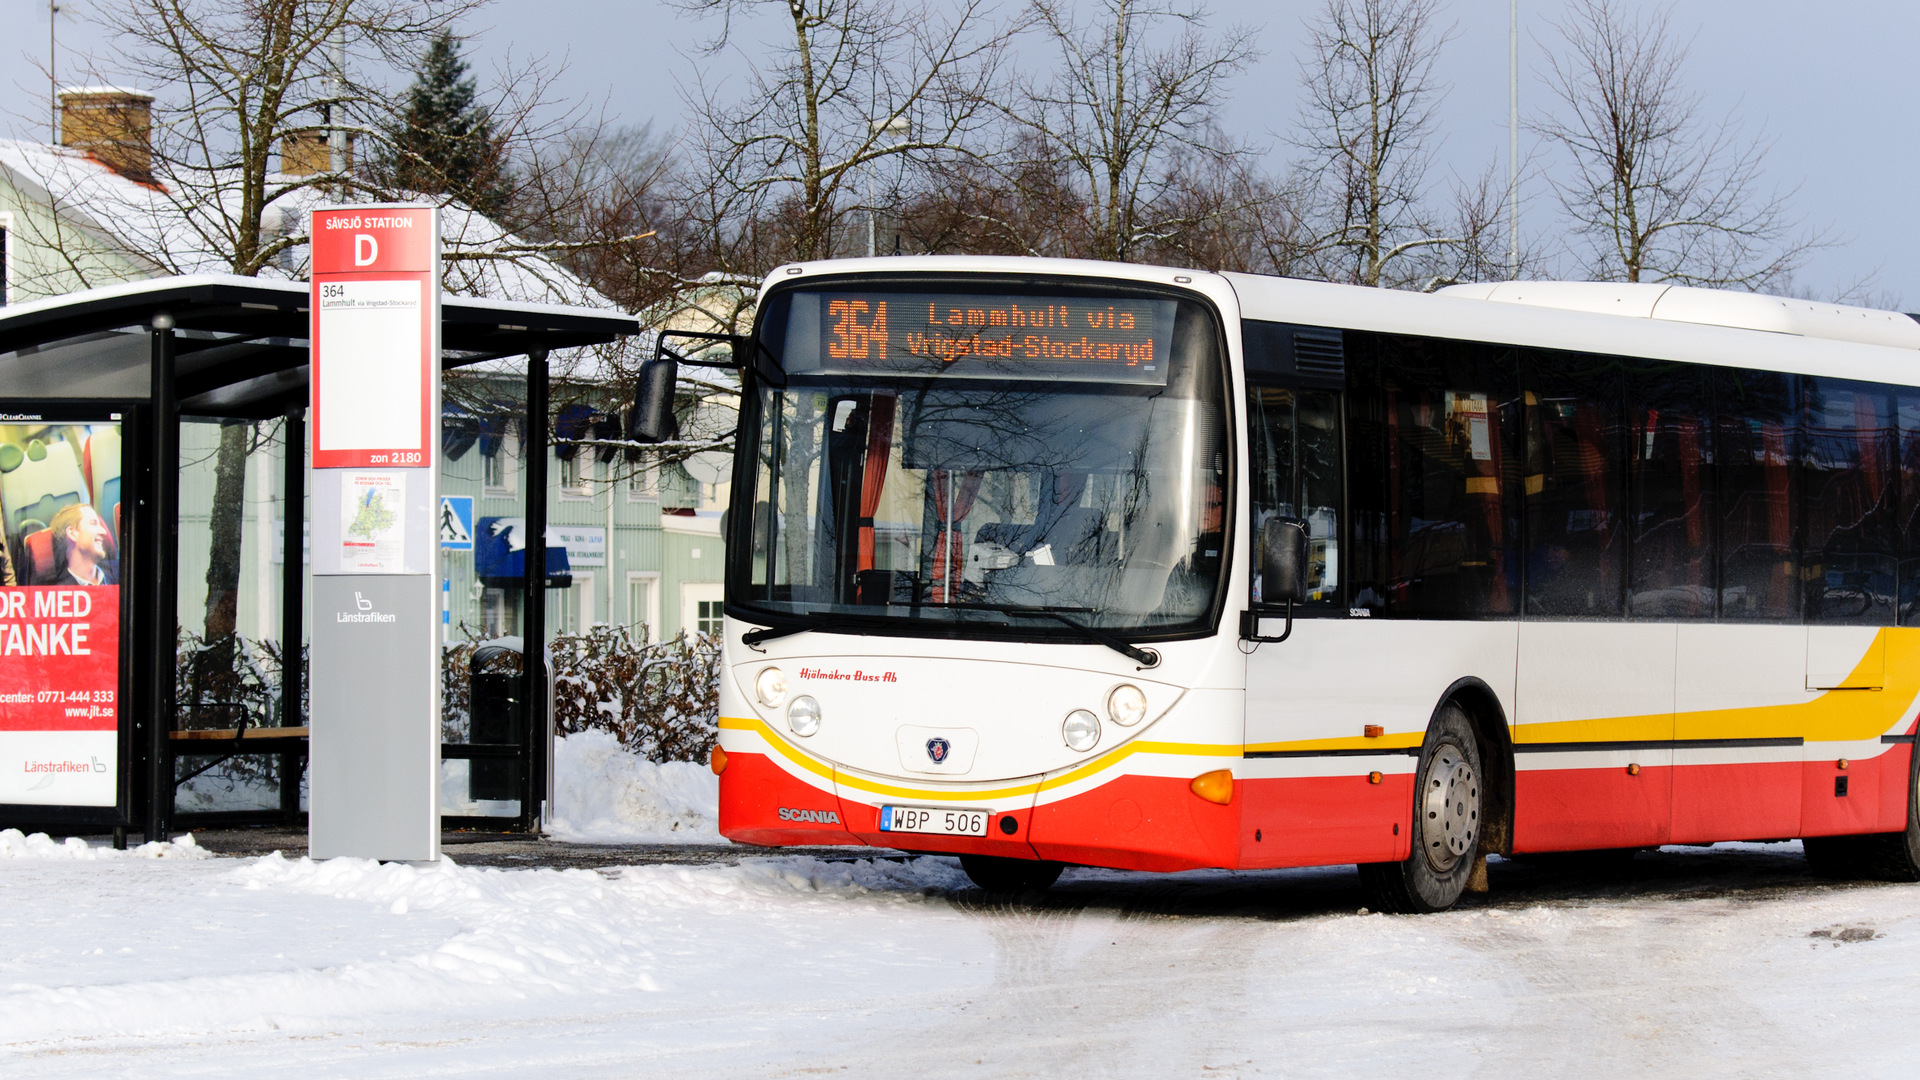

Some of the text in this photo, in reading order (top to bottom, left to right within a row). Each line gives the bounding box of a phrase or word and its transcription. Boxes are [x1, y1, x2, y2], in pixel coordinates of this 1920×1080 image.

[326, 216, 412, 230] SÄVSJÖ STATION
[355, 234, 379, 266] D
[323, 285, 344, 297] 364
[322, 299, 355, 307] Lammhult
[829, 300, 1135, 360] 364 Lammhult via
[907, 332, 1154, 366] Vrigstad-Stockaryd
[370, 452, 422, 463] zon 2180
[35, 591, 91, 617] MED
[337, 612, 396, 623] Länstrafiken
[1350, 608, 1370, 617] SCANIA
[800, 668, 897, 682] Hjälmåkra Buss Ab
[0, 691, 114, 703] center: 0771-444 333
[65, 706, 114, 719] www.jlt.se
[24, 761, 90, 773] Länstrafiken
[778, 807, 841, 825] SCANIA
[894, 810, 930, 830] WBP
[945, 813, 981, 832] 506
